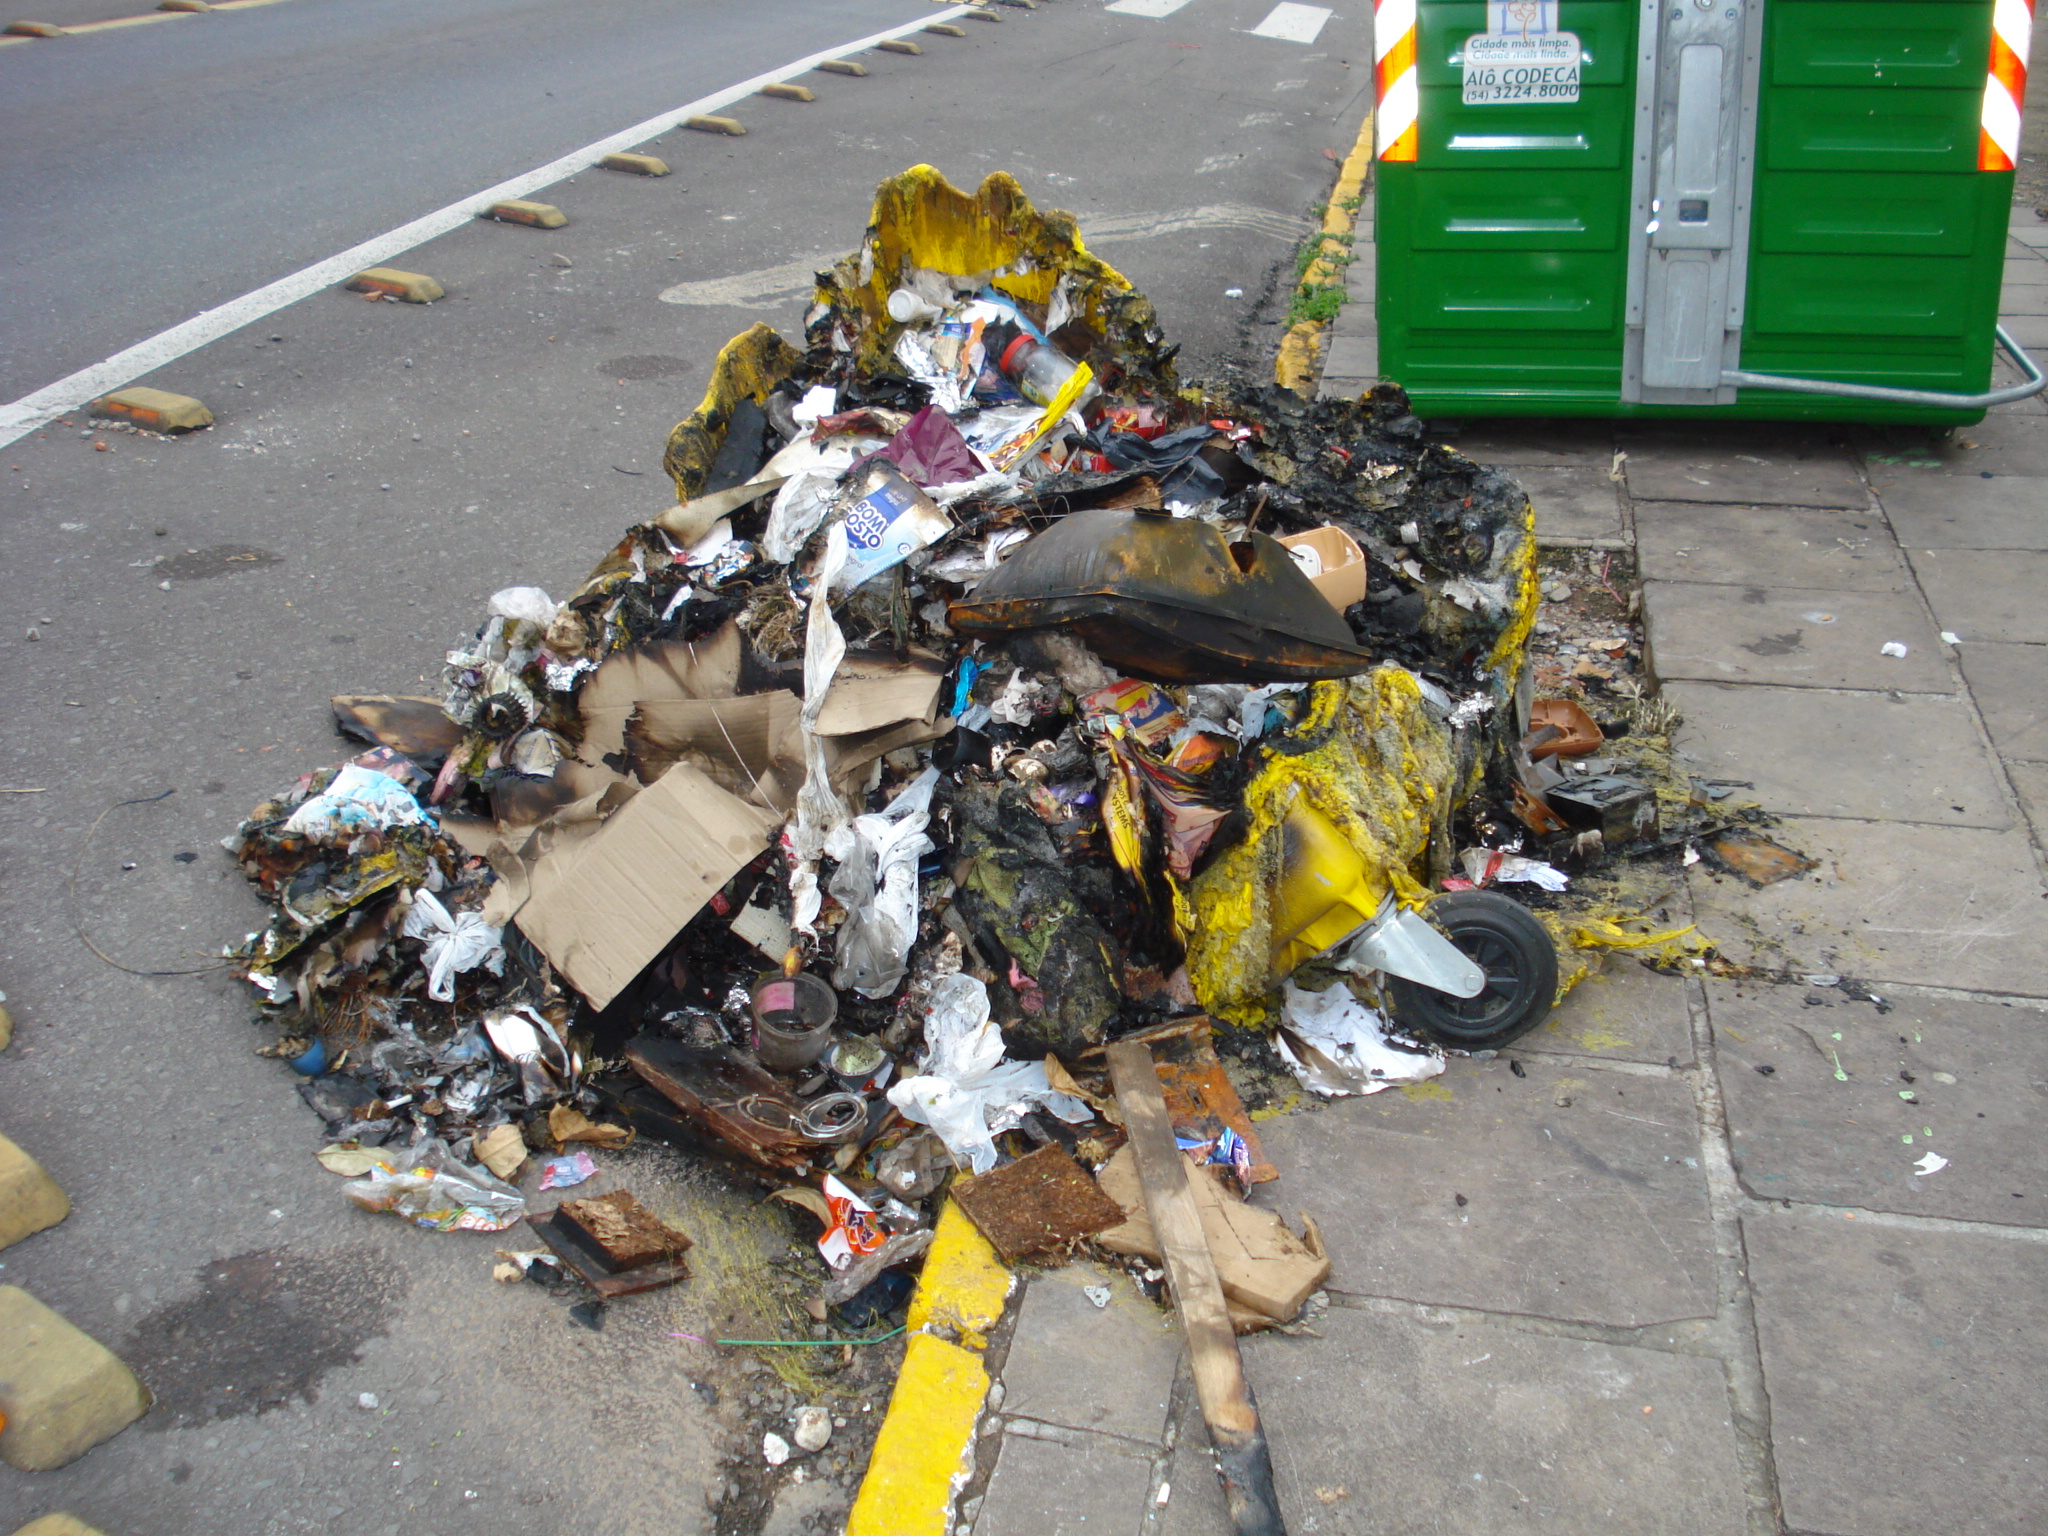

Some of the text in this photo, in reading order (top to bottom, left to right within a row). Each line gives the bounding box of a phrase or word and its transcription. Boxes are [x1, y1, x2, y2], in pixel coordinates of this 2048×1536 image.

[1471, 38, 1571, 50] Cidade mais limpa.
[1473, 49, 1569, 60] Cidade mais linda.
[1465, 66, 1578, 86] Alô CODECA
[1466, 84, 1579, 102] (54) 3224.8000
[855, 501, 884, 533] BOM
